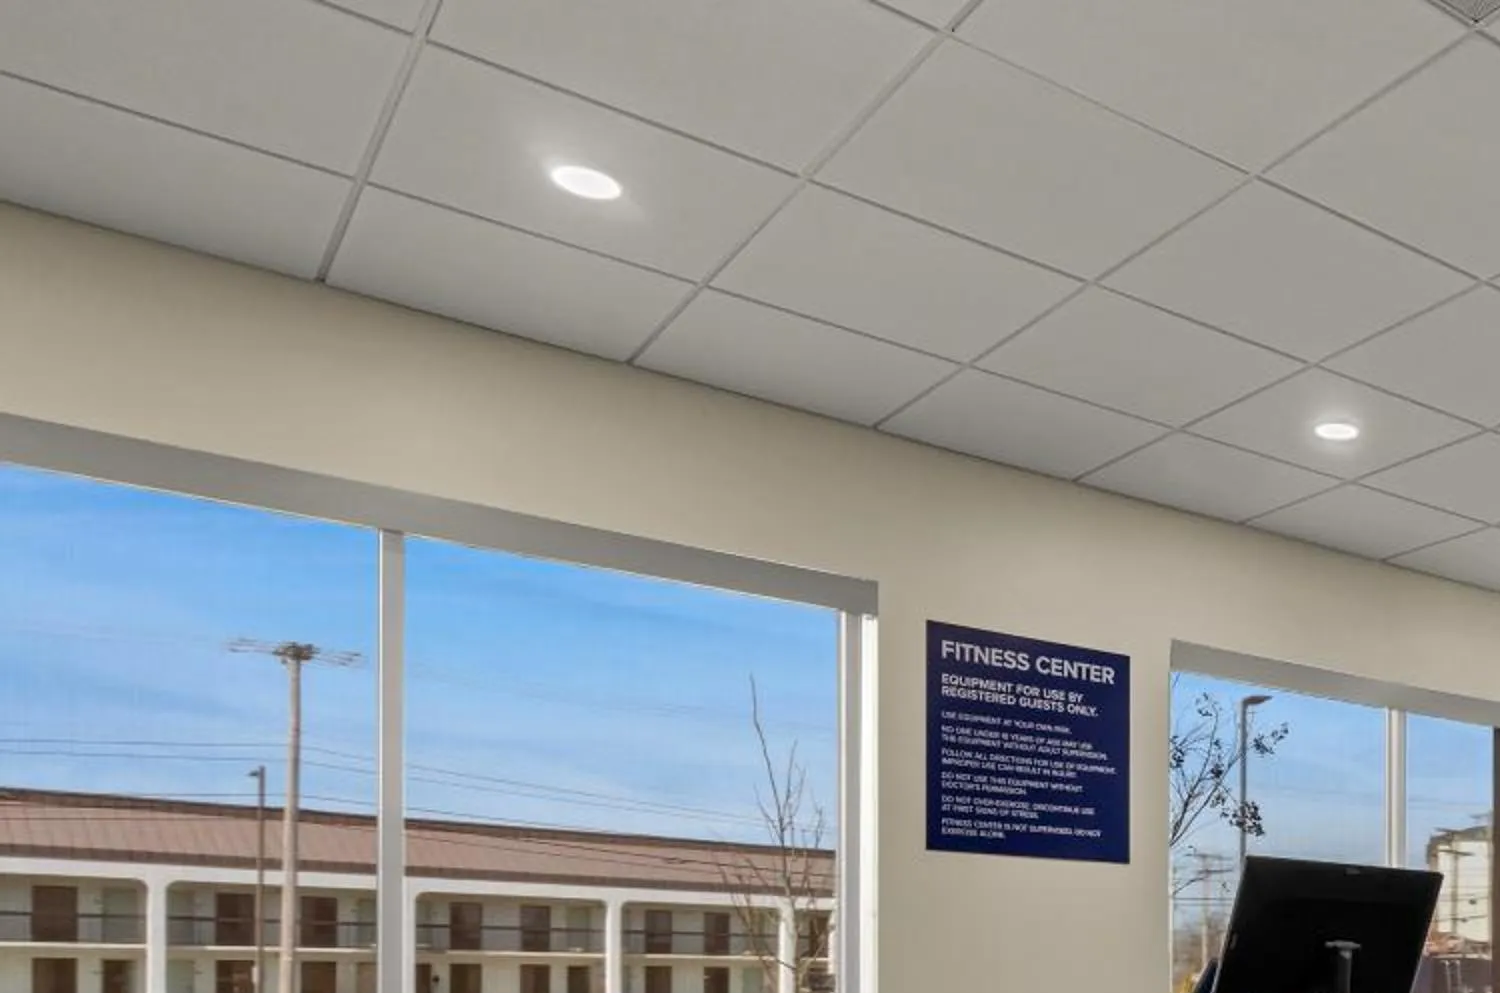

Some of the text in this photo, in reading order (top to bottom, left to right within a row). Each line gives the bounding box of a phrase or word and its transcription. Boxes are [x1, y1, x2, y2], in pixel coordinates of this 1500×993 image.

[941, 639, 1115, 685] FITNESS CENTER
[941, 673, 1084, 704] EQUIPMENT FOR USE BY
[941, 685, 1099, 718] REGISTERED GUESTS ONLY.
